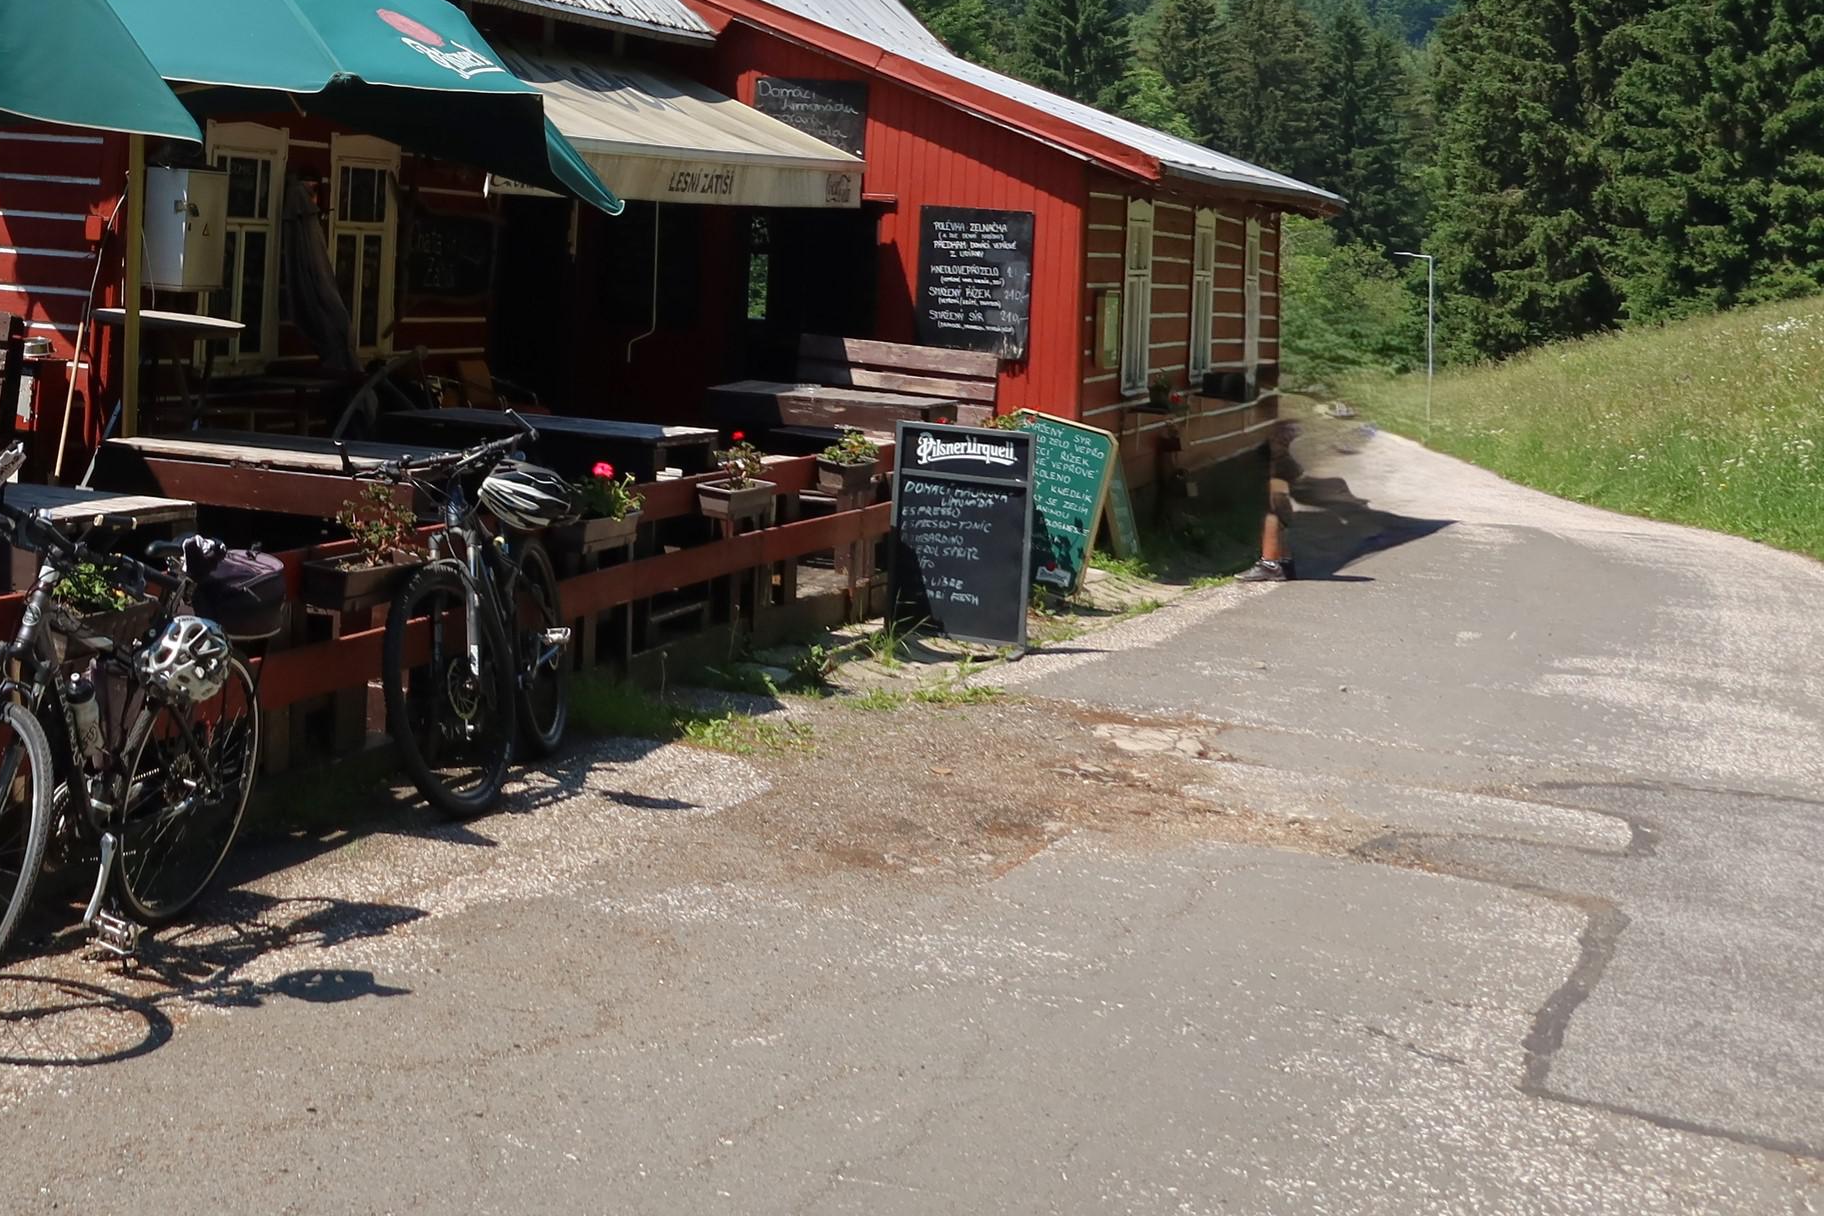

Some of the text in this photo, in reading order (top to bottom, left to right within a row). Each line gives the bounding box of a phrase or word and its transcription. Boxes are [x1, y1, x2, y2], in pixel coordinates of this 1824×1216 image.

[667, 168, 736, 195] LESNÍ ZÁTIŠÍ
[916, 432, 1014, 464] Pilsner Urquell
